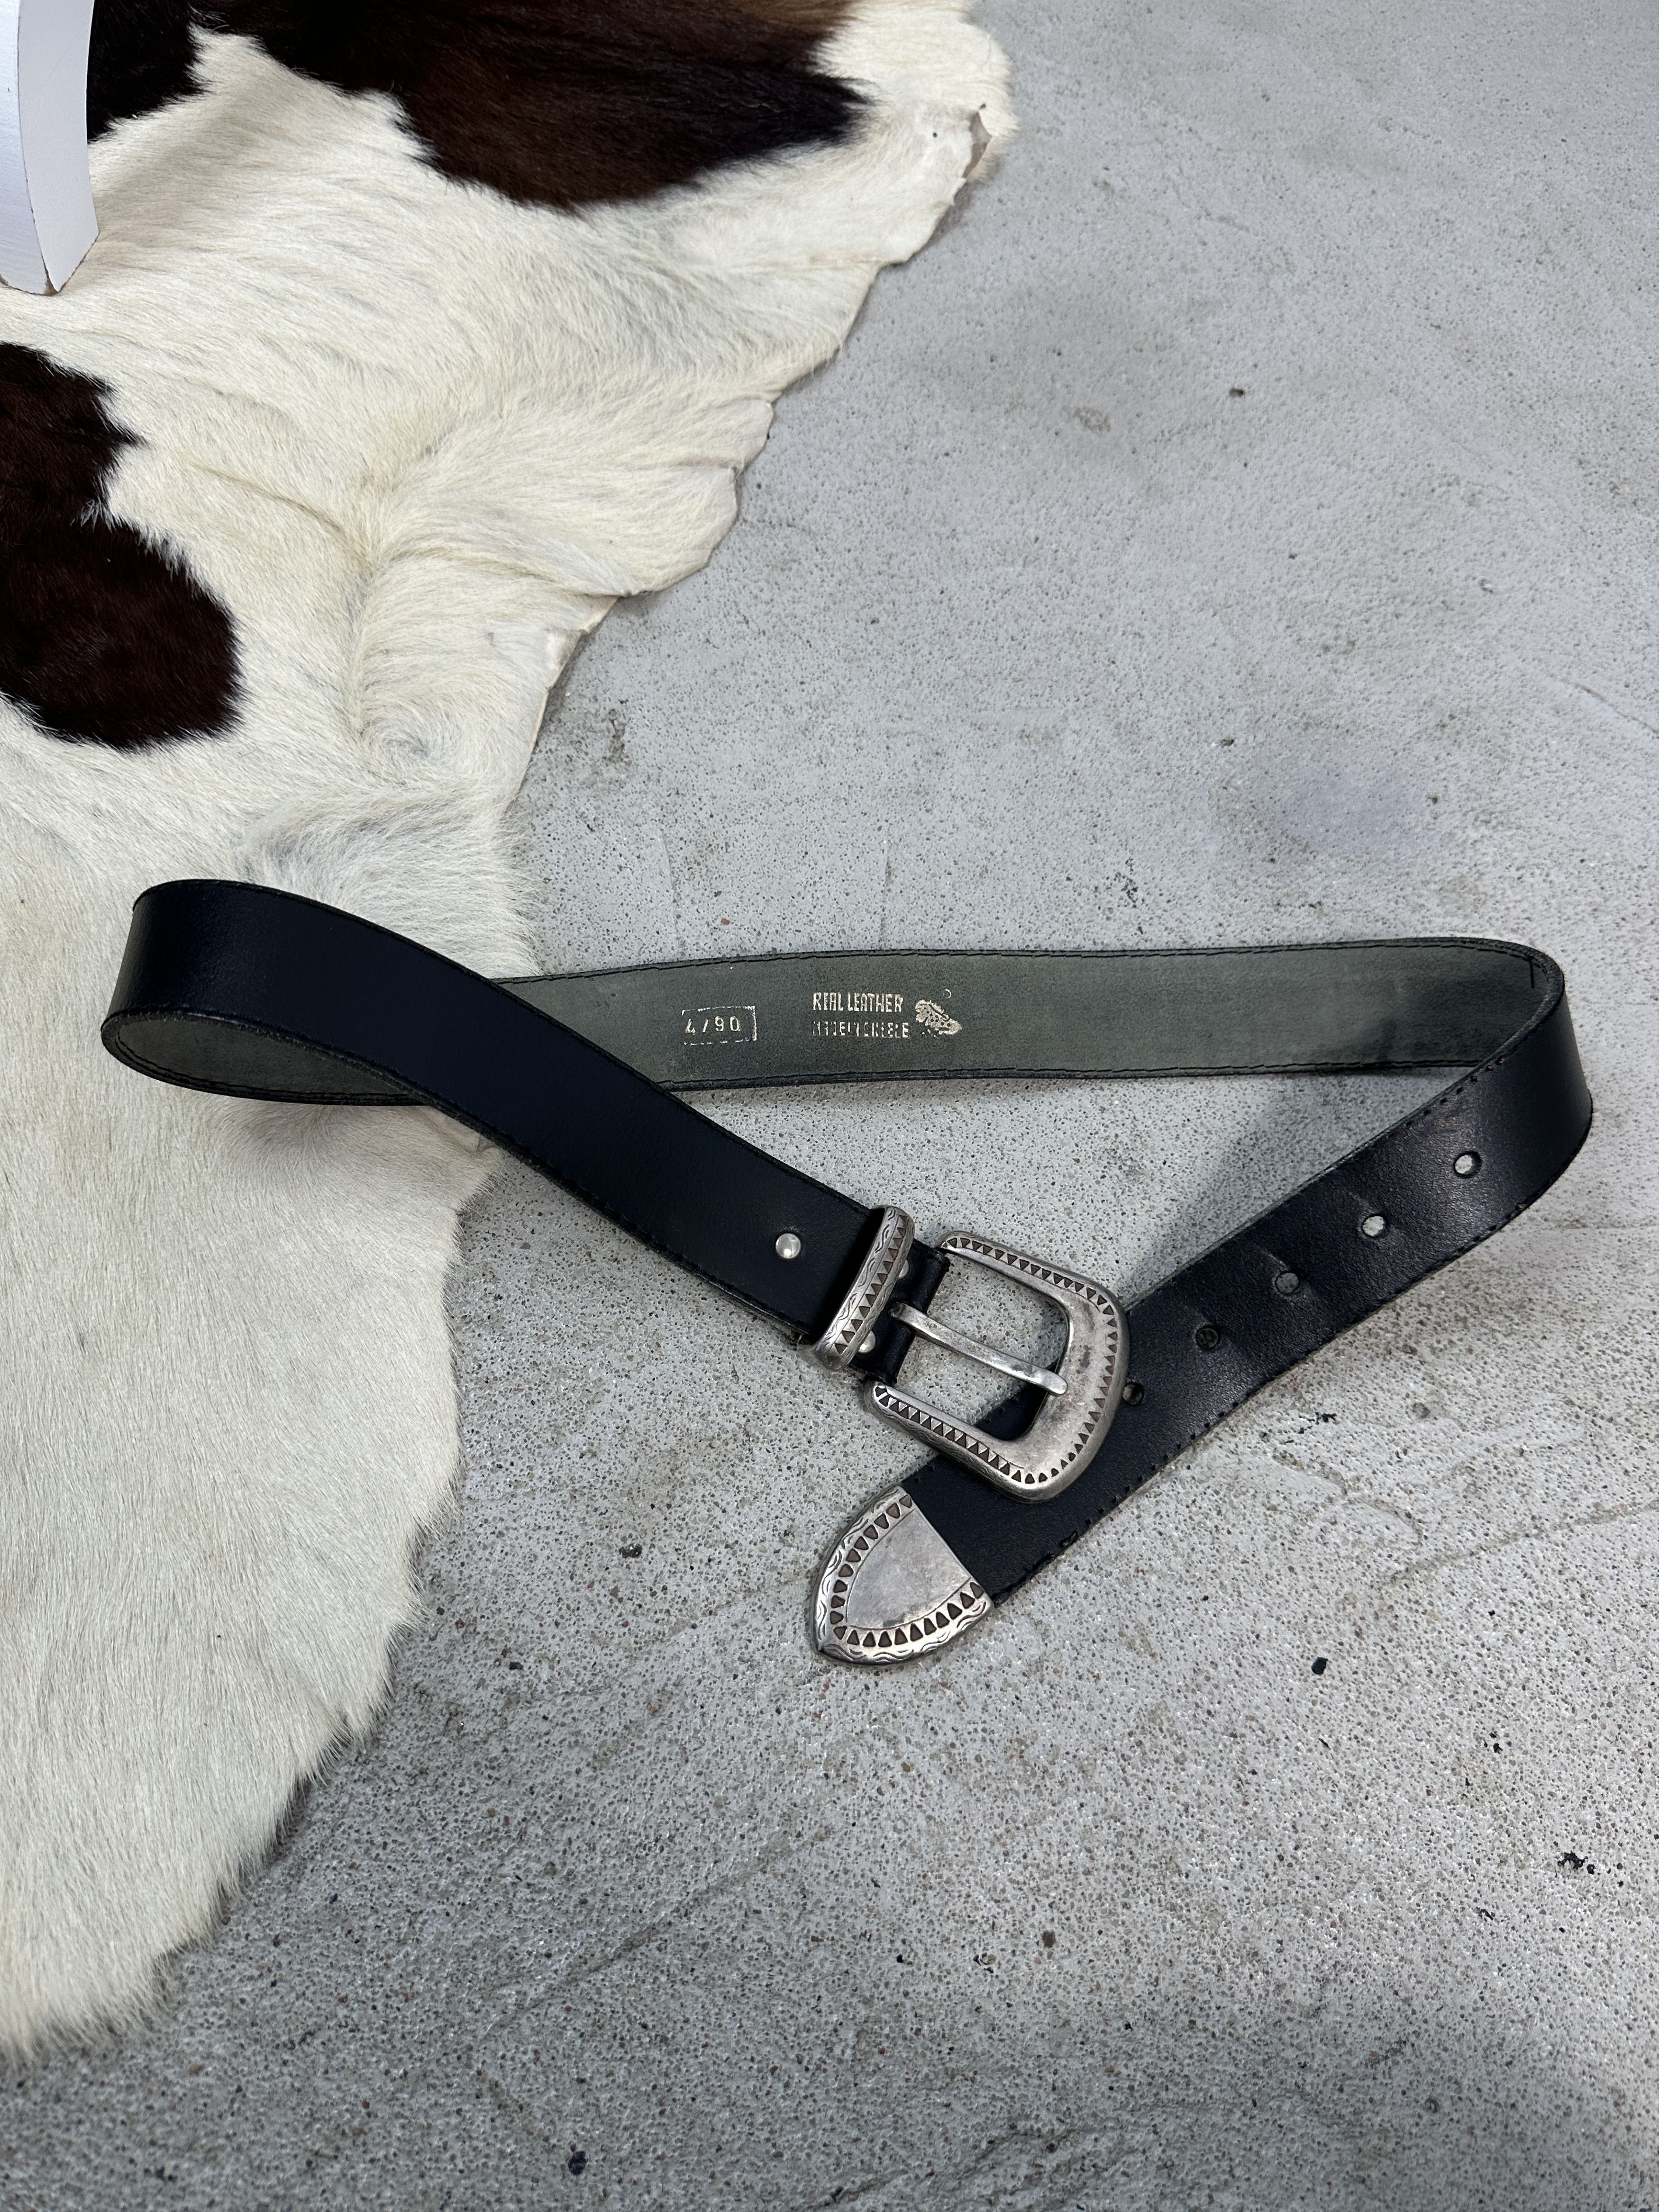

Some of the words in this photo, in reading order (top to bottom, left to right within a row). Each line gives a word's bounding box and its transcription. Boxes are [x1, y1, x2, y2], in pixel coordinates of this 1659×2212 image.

[812, 992, 844, 1011] REAL
[847, 993, 903, 1013] LEATHER
[685, 1016, 740, 1035] 4/90
